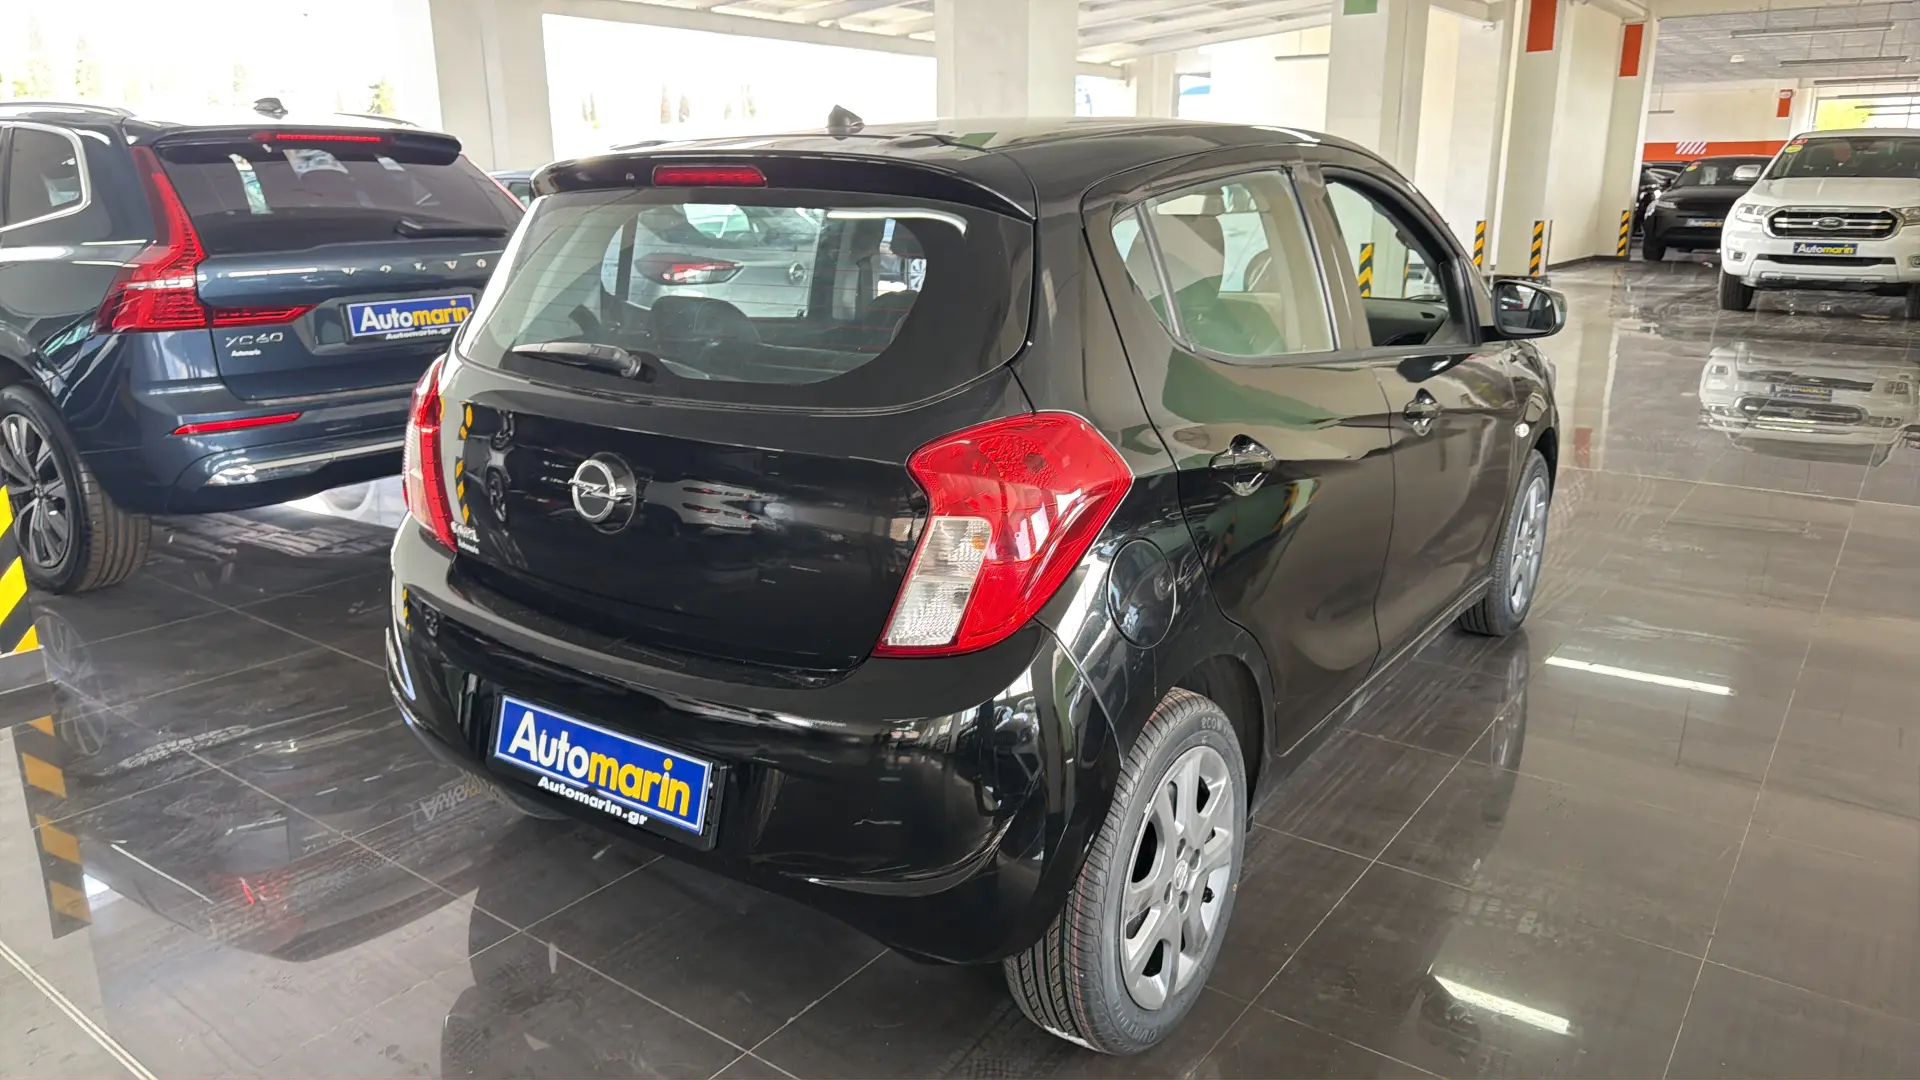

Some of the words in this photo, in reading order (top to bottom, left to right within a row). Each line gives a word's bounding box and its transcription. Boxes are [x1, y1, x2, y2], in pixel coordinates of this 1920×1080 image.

[1796, 243, 1854, 254] Automarin
[340, 258, 487, 276] VOLVO
[360, 299, 470, 332] Automarin
[385, 327, 452, 341] Automarin.gr
[507, 710, 691, 817] Automarin
[537, 775, 648, 826] Automarin.gr
